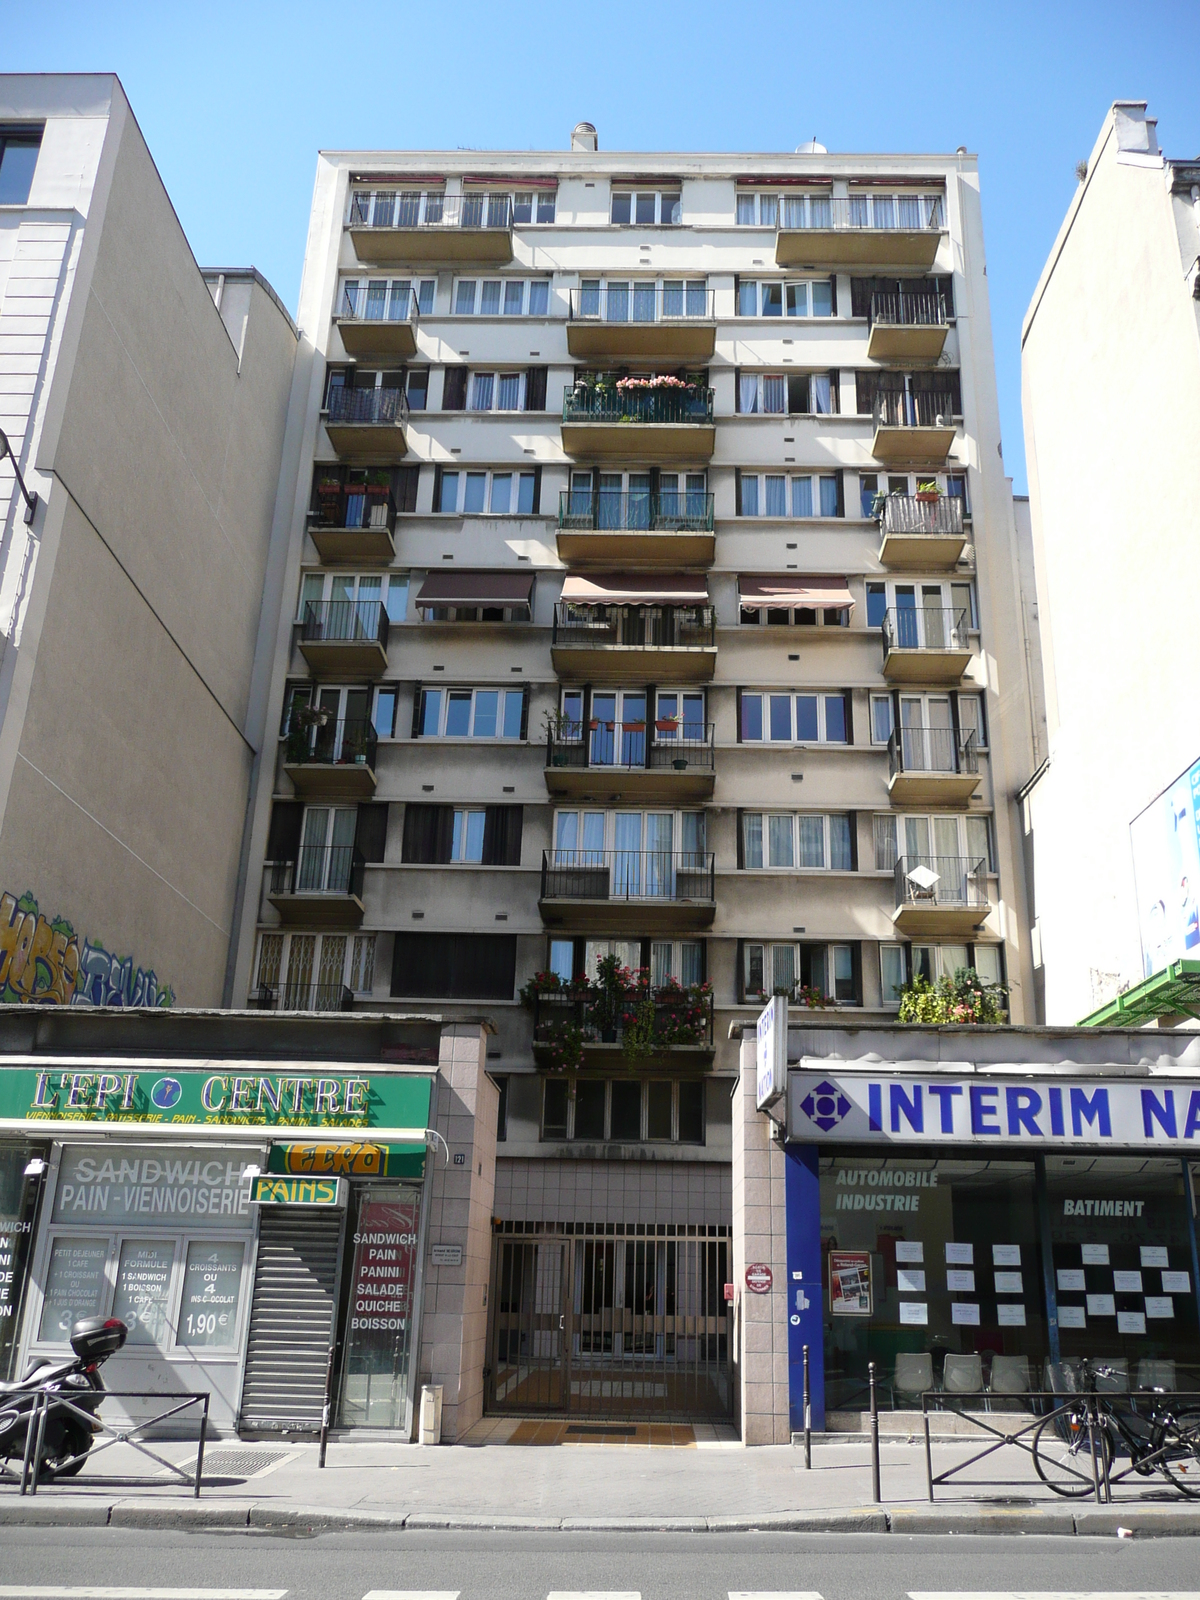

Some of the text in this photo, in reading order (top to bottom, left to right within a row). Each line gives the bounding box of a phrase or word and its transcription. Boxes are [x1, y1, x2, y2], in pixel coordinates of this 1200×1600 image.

[31, 1072, 370, 1115] L'EPI CENTRE
[868, 1083, 1113, 1138] INTERIM
[105, 1112, 163, 1123] PATISSERIE
[171, 1114, 197, 1124] PAIN
[203, 1115, 267, 1125] SANDWICHS
[319, 1117, 369, 1128] SALADES
[455, 1155, 464, 1164] 121
[75, 1158, 247, 1187] SANDWICH
[835, 1169, 938, 1187] AUTOMOBILE
[256, 1177, 335, 1203] PAINS
[60, 1185, 249, 1215] PAIN VIENNOISERIE
[835, 1194, 920, 1212] INDUSTRIE
[1063, 1199, 1145, 1217] BATIMENT
[353, 1232, 416, 1245] SANDWICH
[54, 1249, 72, 1257] PETIT
[137, 1251, 158, 1259] MIDI
[207, 1253, 219, 1263] 4
[369, 1249, 396, 1260] PAIN
[124, 1259, 168, 1269] FORMULE
[189, 1263, 237, 1272] CROISSANTS
[63, 1270, 99, 1279] CROISSANT
[127, 1272, 167, 1281] SANDWICH
[203, 1273, 218, 1281] OU
[360, 1266, 400, 1278] PANINI
[70, 1280, 80, 1288] OU
[204, 1283, 216, 1294] 4
[357, 1283, 404, 1295] SALADE
[202, 1295, 235, 1304] COCOLAT
[356, 1300, 401, 1312] QUICHE
[59, 1309, 73, 1331] 3
[125, 1310, 137, 1332] 3
[351, 1317, 405, 1330] BOISSON
